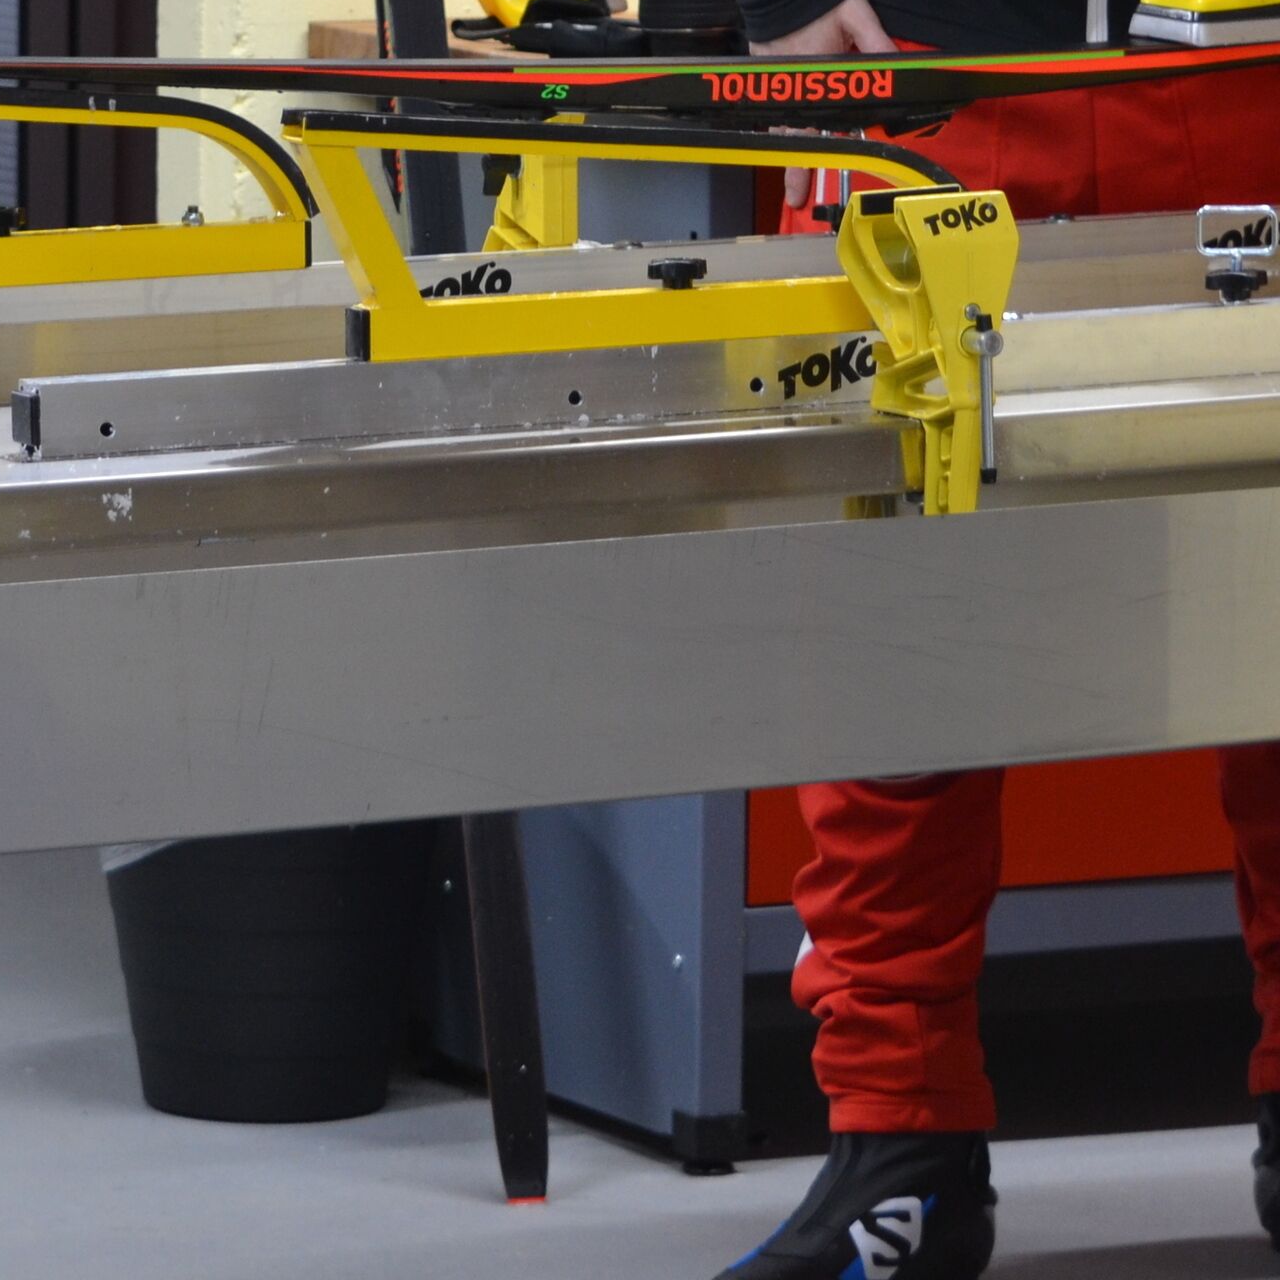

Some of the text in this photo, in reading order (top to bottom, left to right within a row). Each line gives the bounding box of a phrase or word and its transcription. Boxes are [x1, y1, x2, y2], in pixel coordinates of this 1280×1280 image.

[540, 83, 570, 100] S2
[702, 70, 893, 101] ROSSIGNOL
[924, 199, 998, 236] TOKO
